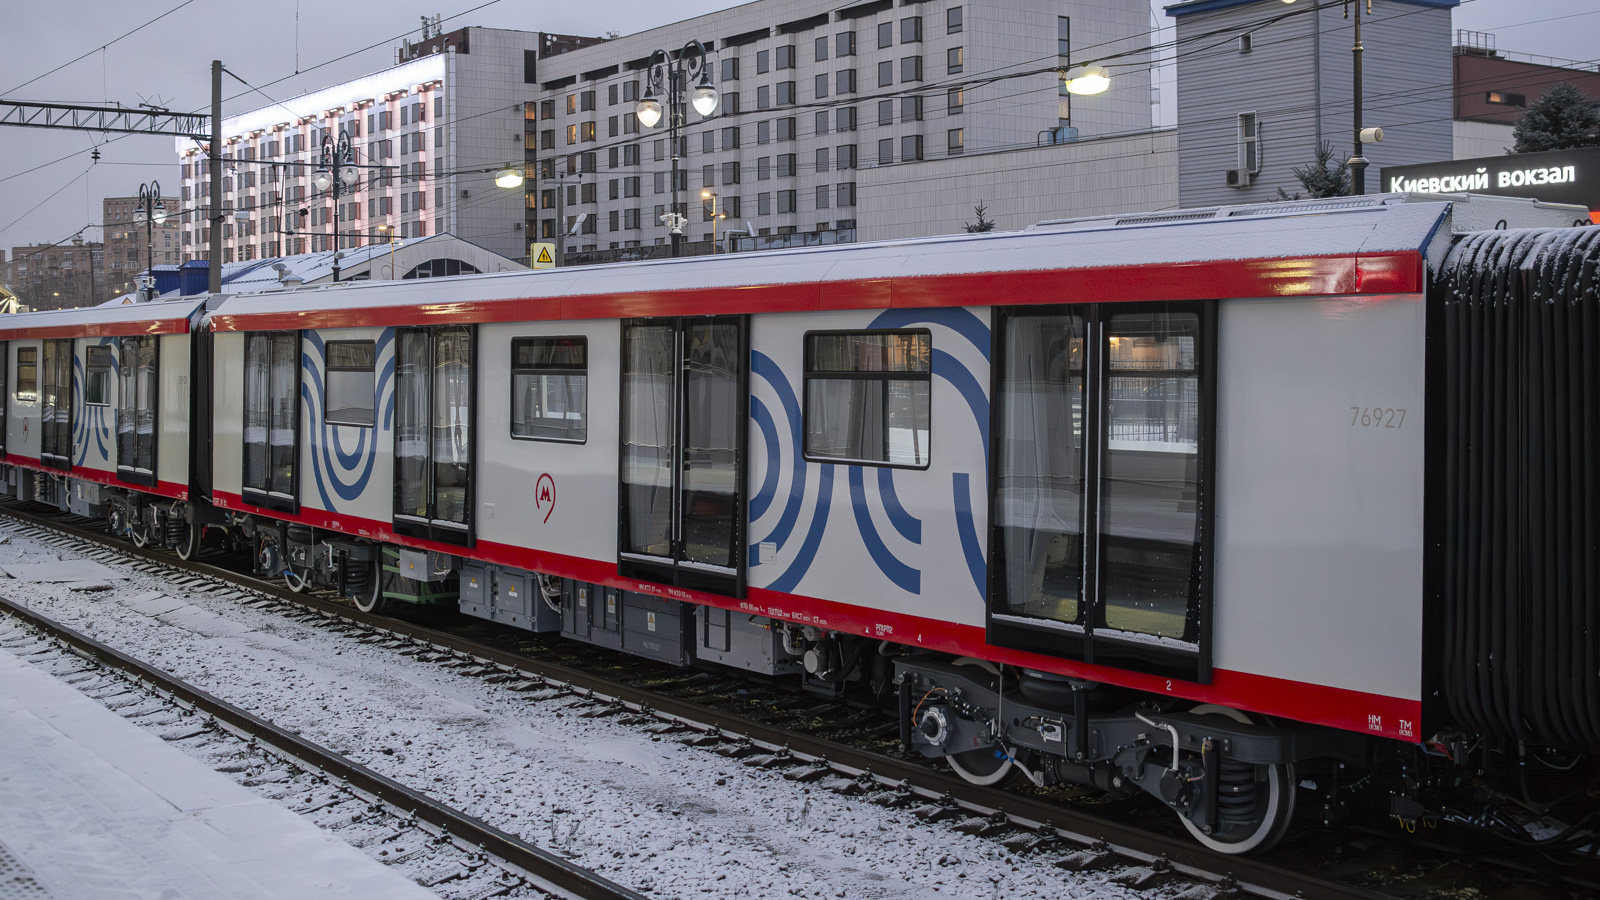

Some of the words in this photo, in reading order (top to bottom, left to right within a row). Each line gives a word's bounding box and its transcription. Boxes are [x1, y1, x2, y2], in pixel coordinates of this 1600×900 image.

[1390, 168, 1489, 193] Киевский
[1498, 165, 1576, 188] вокзал
[1350, 406, 1407, 429] 76927
[1166, 680, 1172, 691] 2
